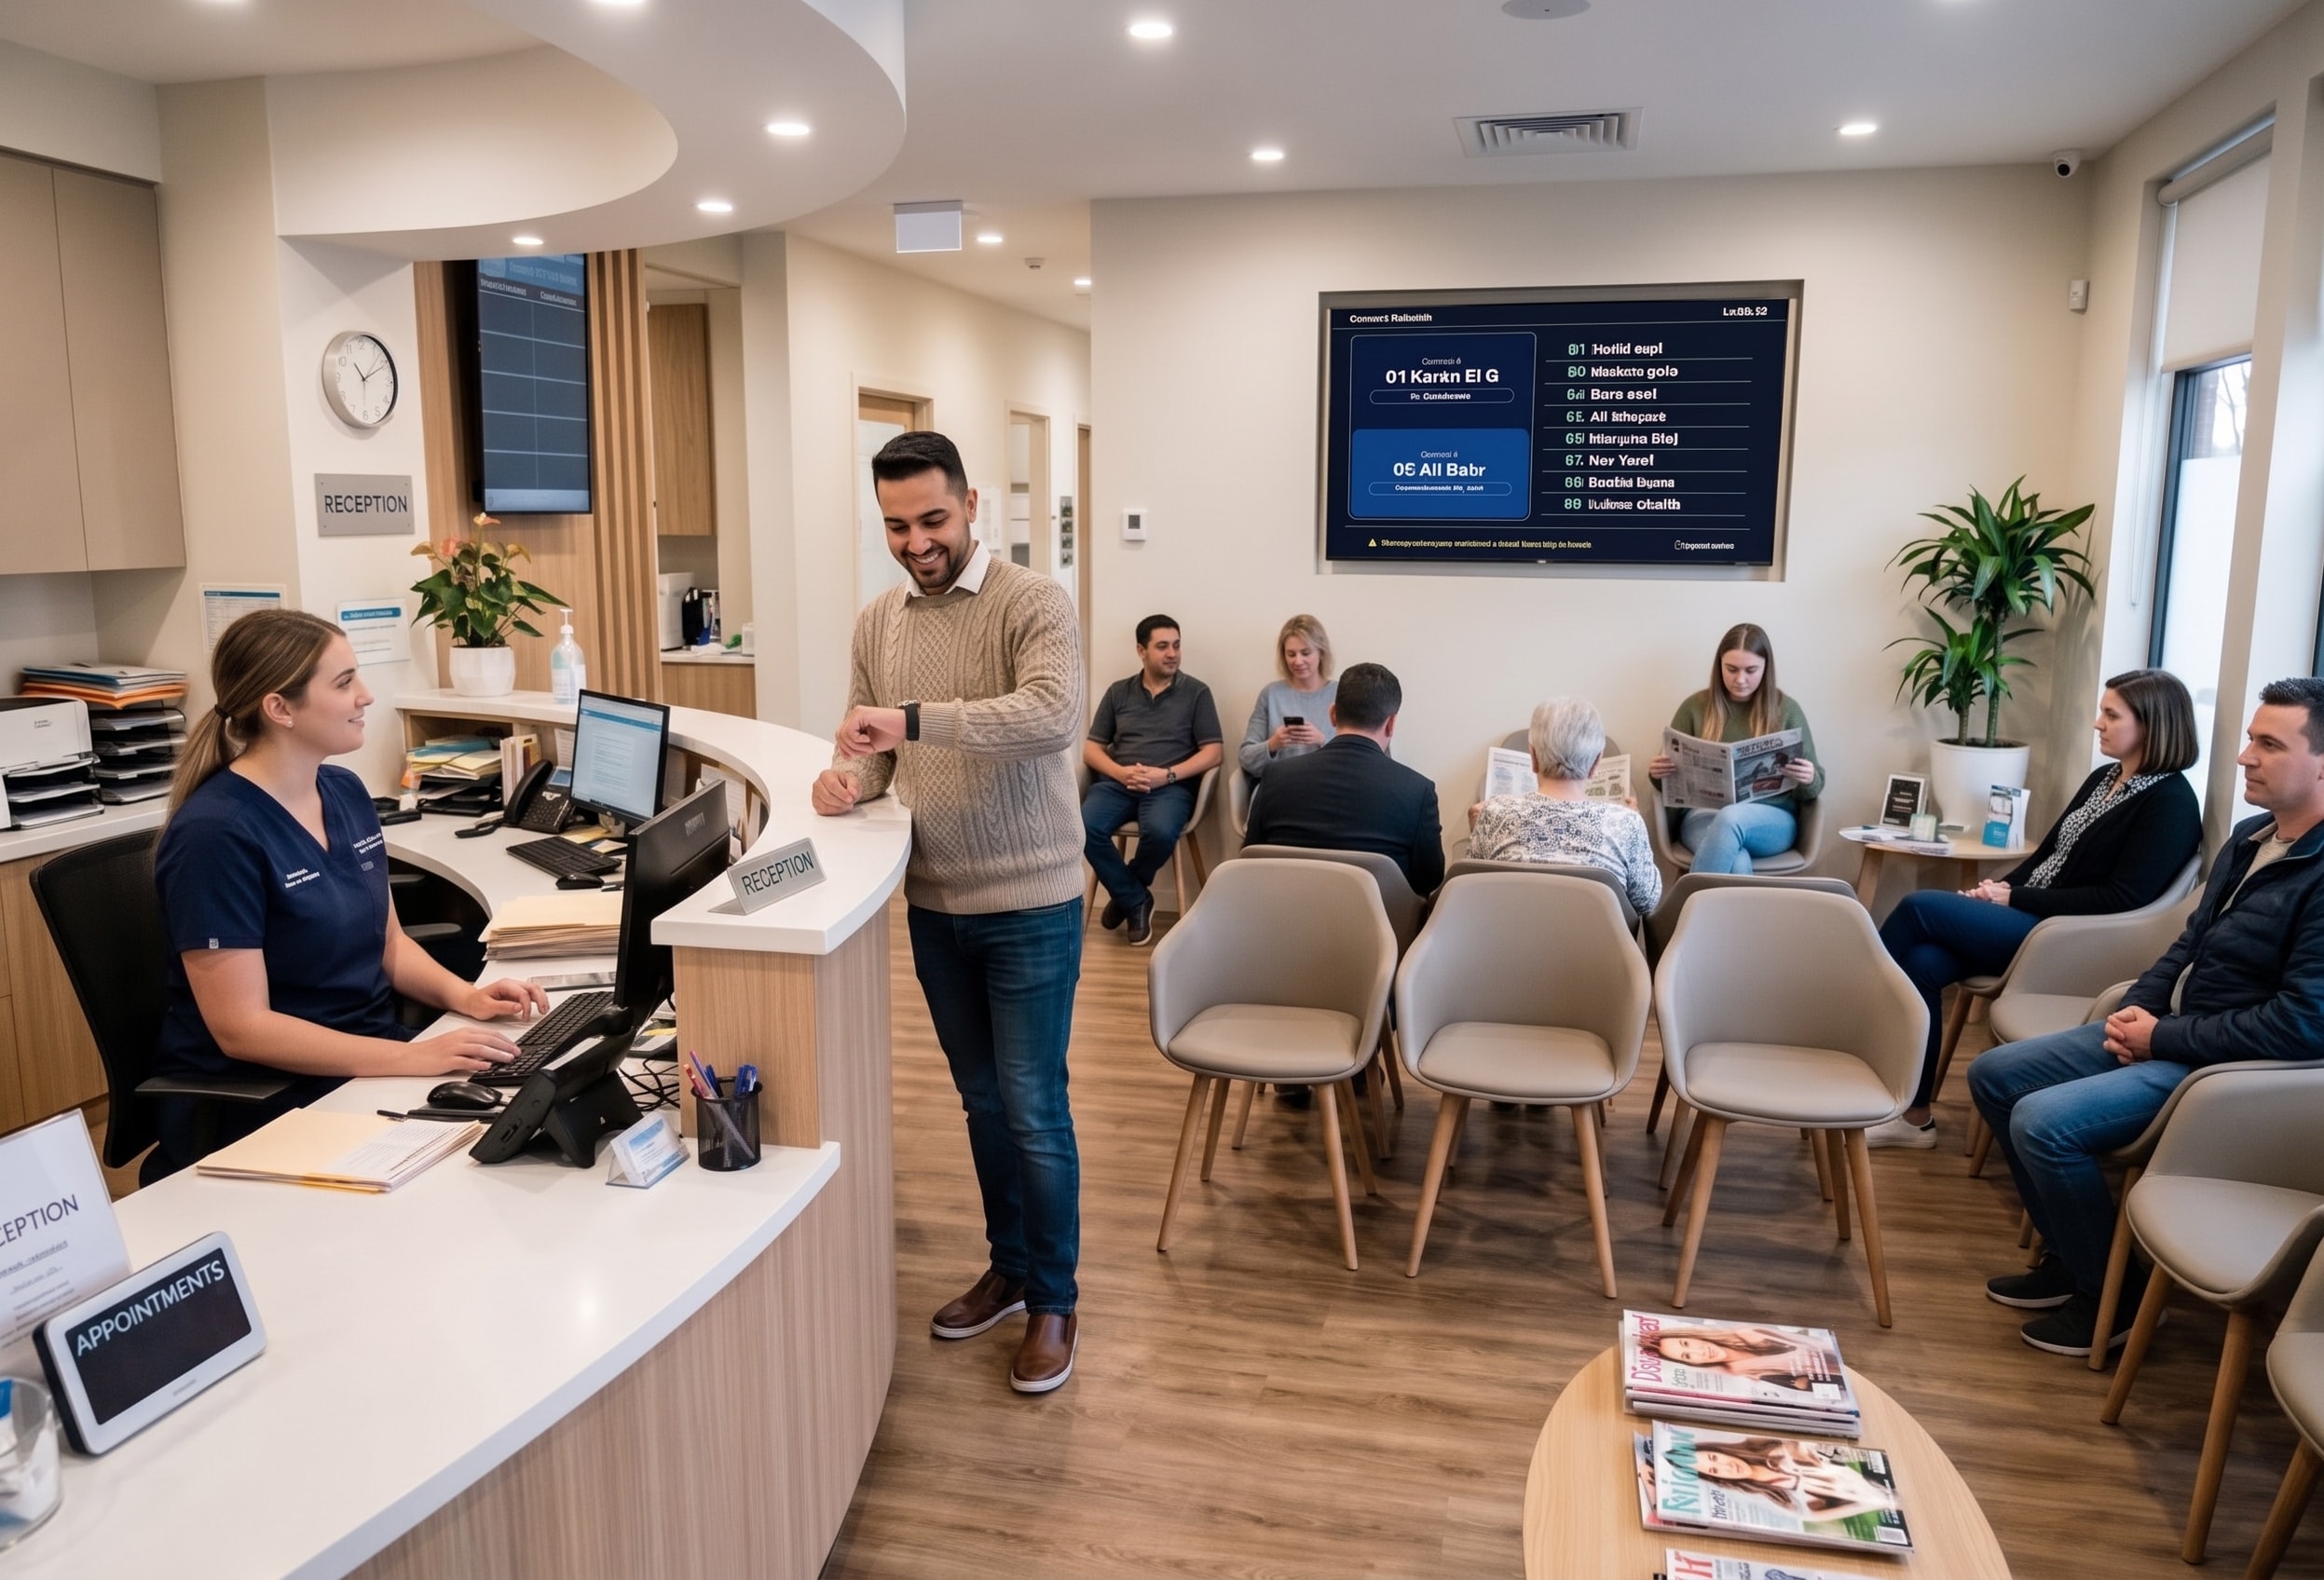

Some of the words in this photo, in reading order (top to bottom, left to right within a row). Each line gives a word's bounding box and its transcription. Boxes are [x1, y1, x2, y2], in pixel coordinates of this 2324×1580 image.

[1385, 369, 1406, 384] 01
[1485, 368, 1499, 383] G
[324, 495, 408, 513] RECEPTION
[741, 851, 814, 895] RECEPTION
[76, 1260, 226, 1357] APPOINTMENTS
